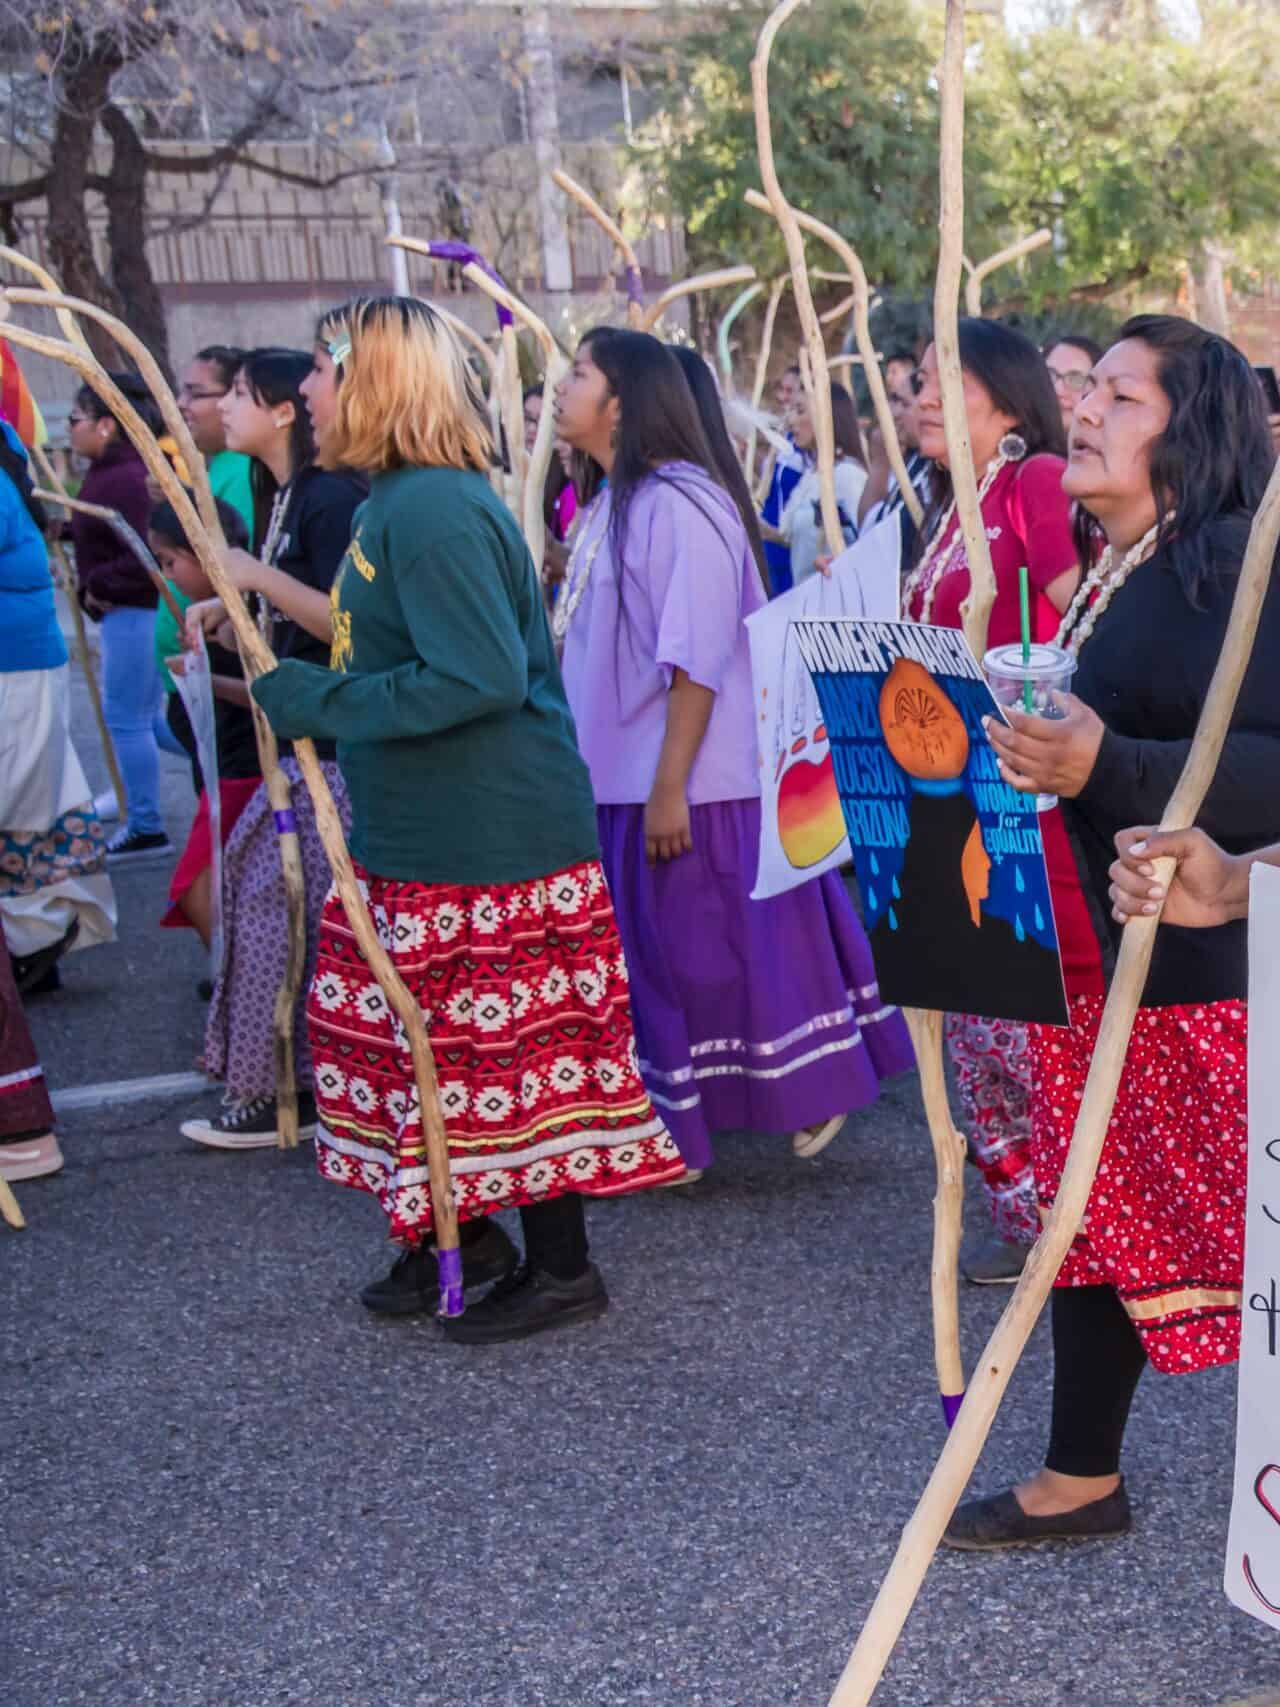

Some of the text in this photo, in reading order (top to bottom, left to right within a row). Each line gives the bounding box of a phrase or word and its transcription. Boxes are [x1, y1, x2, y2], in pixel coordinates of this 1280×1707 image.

[794, 621, 986, 682] WOMEN'S MARCH
[832, 744, 907, 796] TUCSON
[997, 810, 1022, 834] for
[983, 828, 1043, 858] EQUALITY
